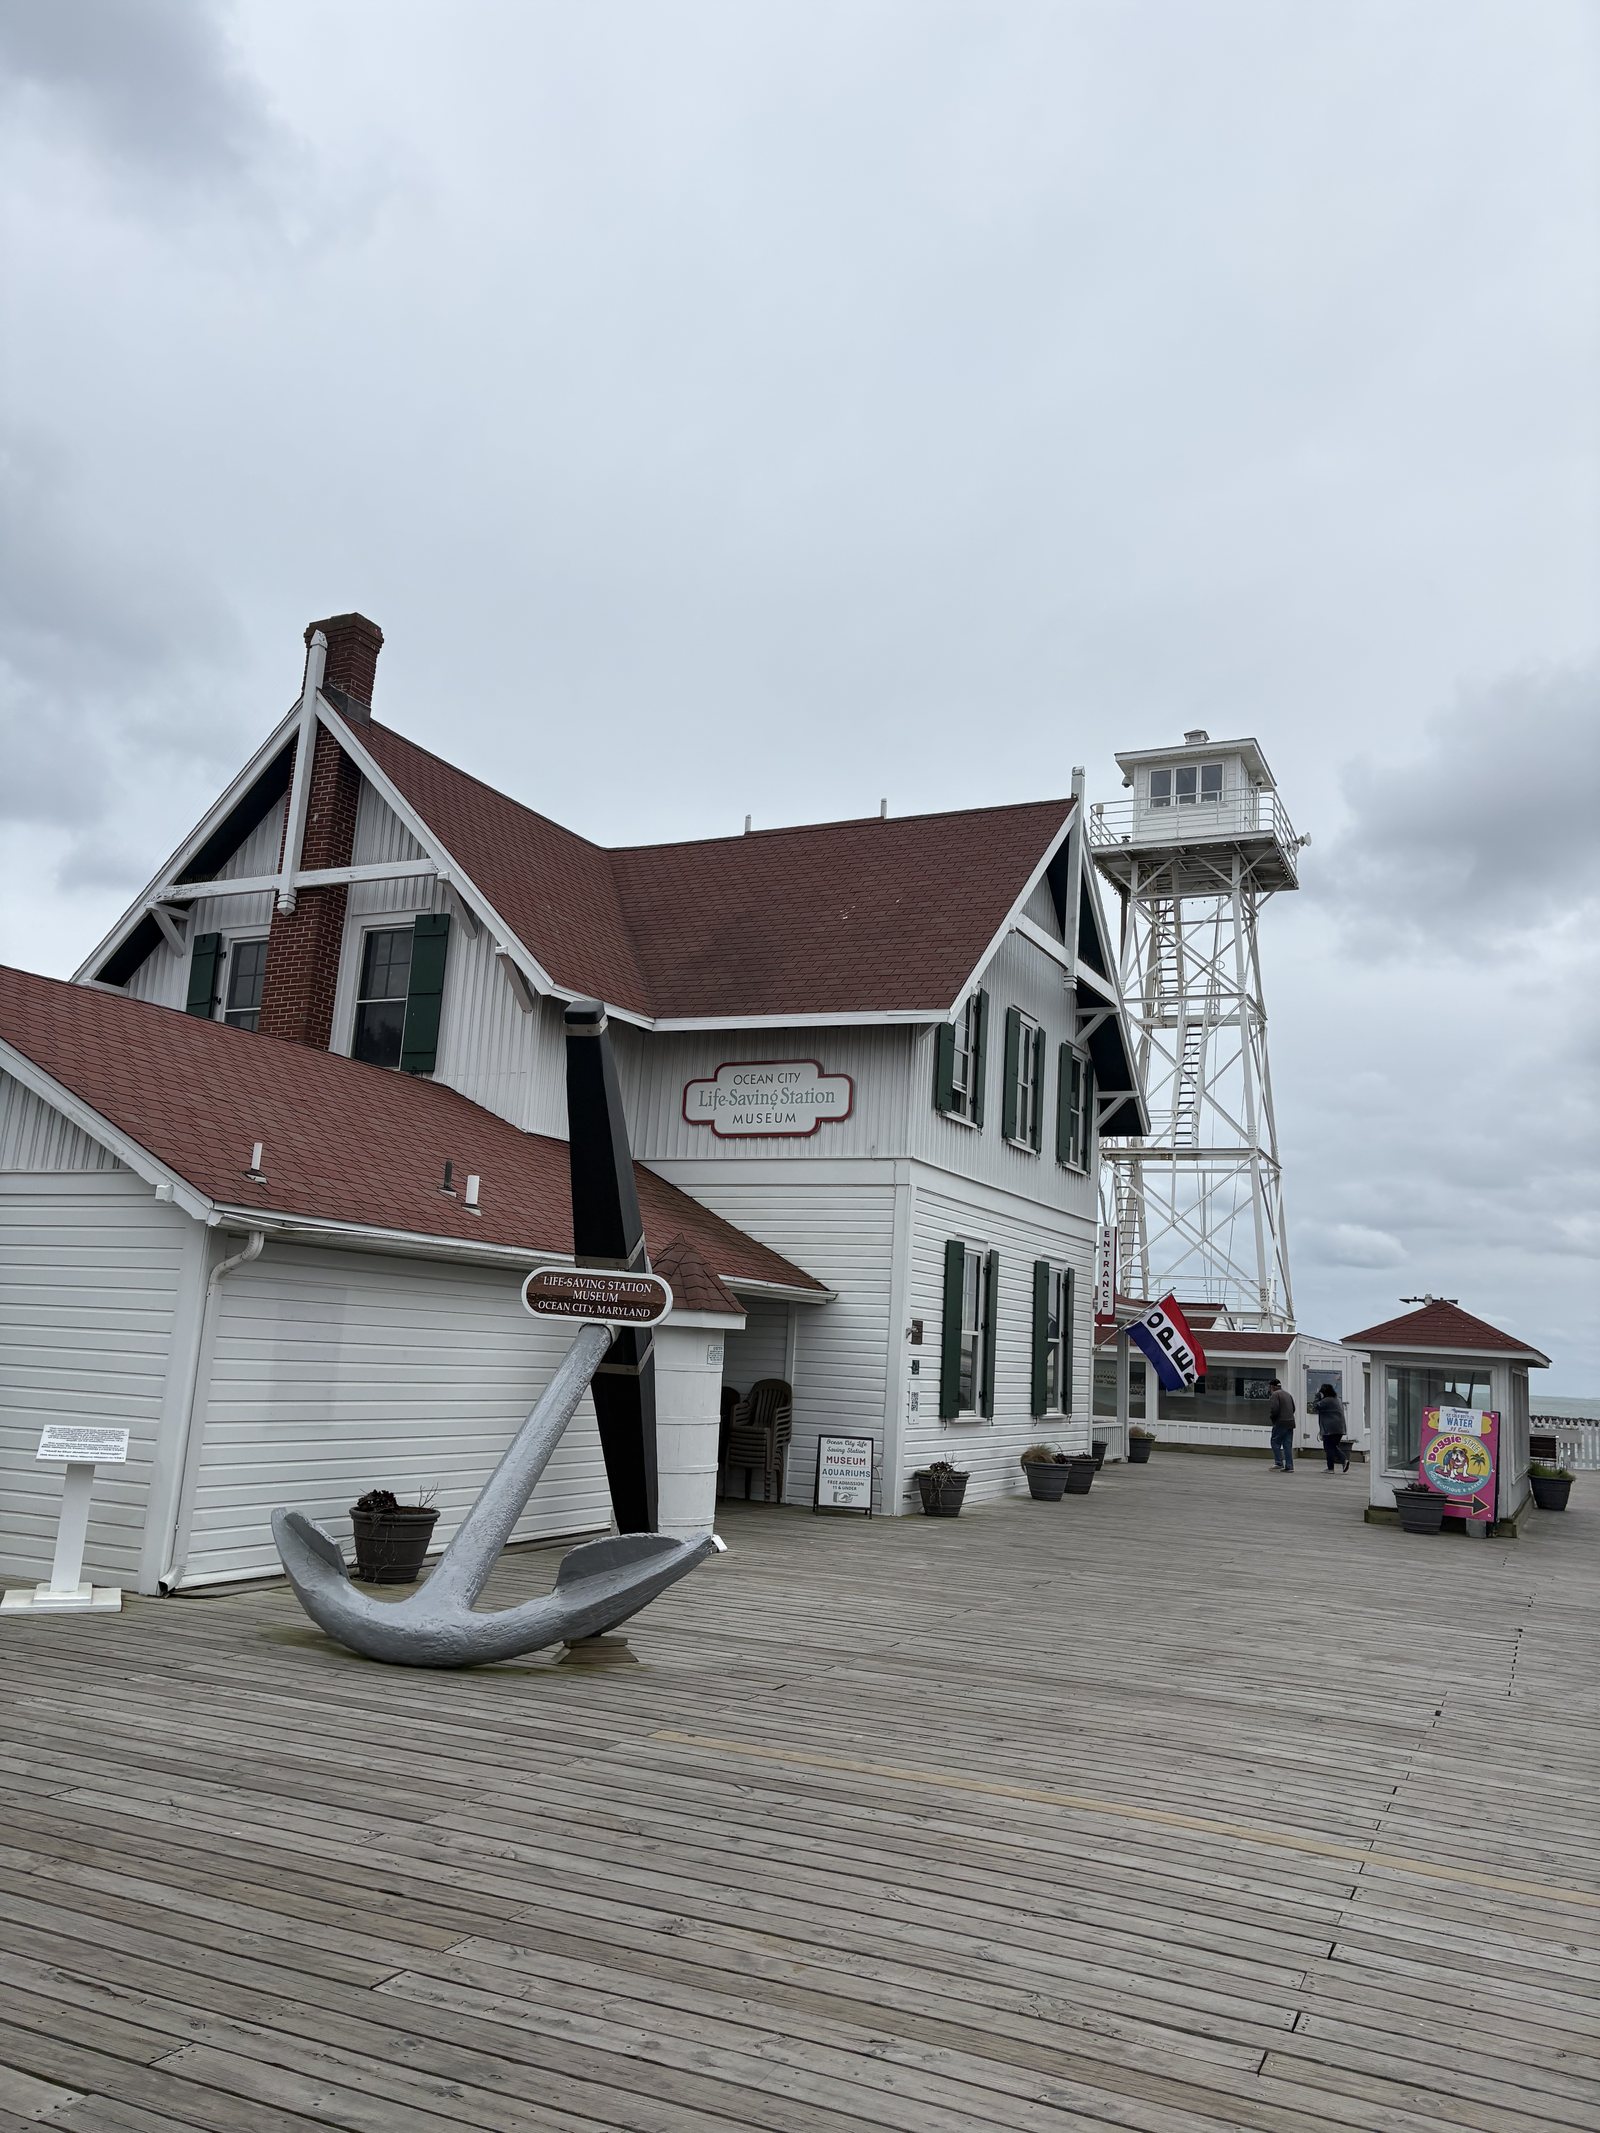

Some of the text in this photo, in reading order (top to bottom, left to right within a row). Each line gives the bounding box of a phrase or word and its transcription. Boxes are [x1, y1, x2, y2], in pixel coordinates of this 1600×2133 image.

[733, 1072, 801, 1086] OCEAN CITY
[698, 1086, 836, 1111] Life-Saving Station
[732, 1112, 797, 1124] MUSEUM
[1102, 1230, 1111, 1308] ENTRANCE
[543, 1276, 652, 1293] LIFE-SAVING STATION
[572, 1290, 619, 1303] MUSEUM
[538, 1300, 651, 1318] OCEAN CITY, MARYLAND
[1446, 1417, 1473, 1428] WATER
[827, 1446, 845, 1455] Saving
[1427, 1434, 1462, 1462] Doggie
[826, 1456, 866, 1465] MUSEUM
[822, 1468, 870, 1477] AQUARIUMS
